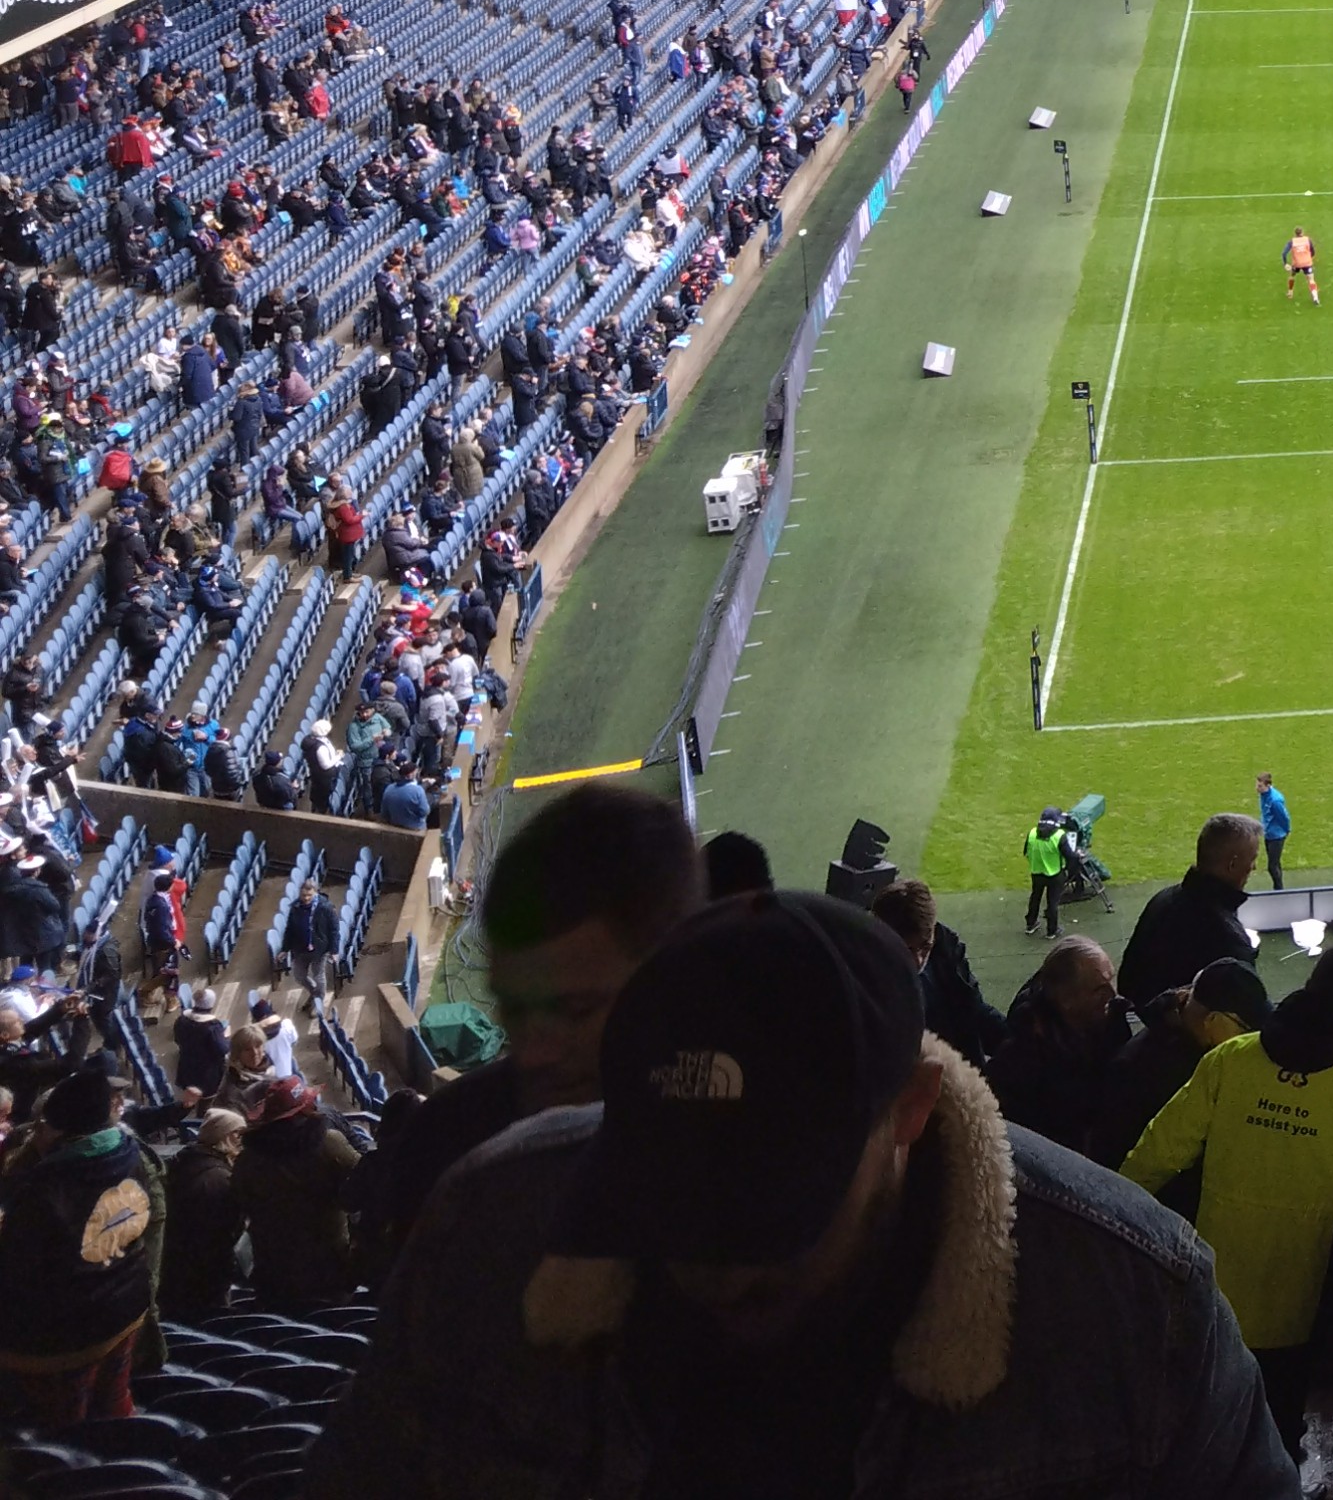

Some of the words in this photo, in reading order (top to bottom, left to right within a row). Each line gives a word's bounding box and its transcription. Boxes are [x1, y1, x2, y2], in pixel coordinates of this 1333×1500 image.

[1257, 1097, 1291, 1115] Here
[1294, 1105, 1310, 1119] to
[1246, 1113, 1290, 1132] assist
[1290, 1123, 1318, 1138] you
